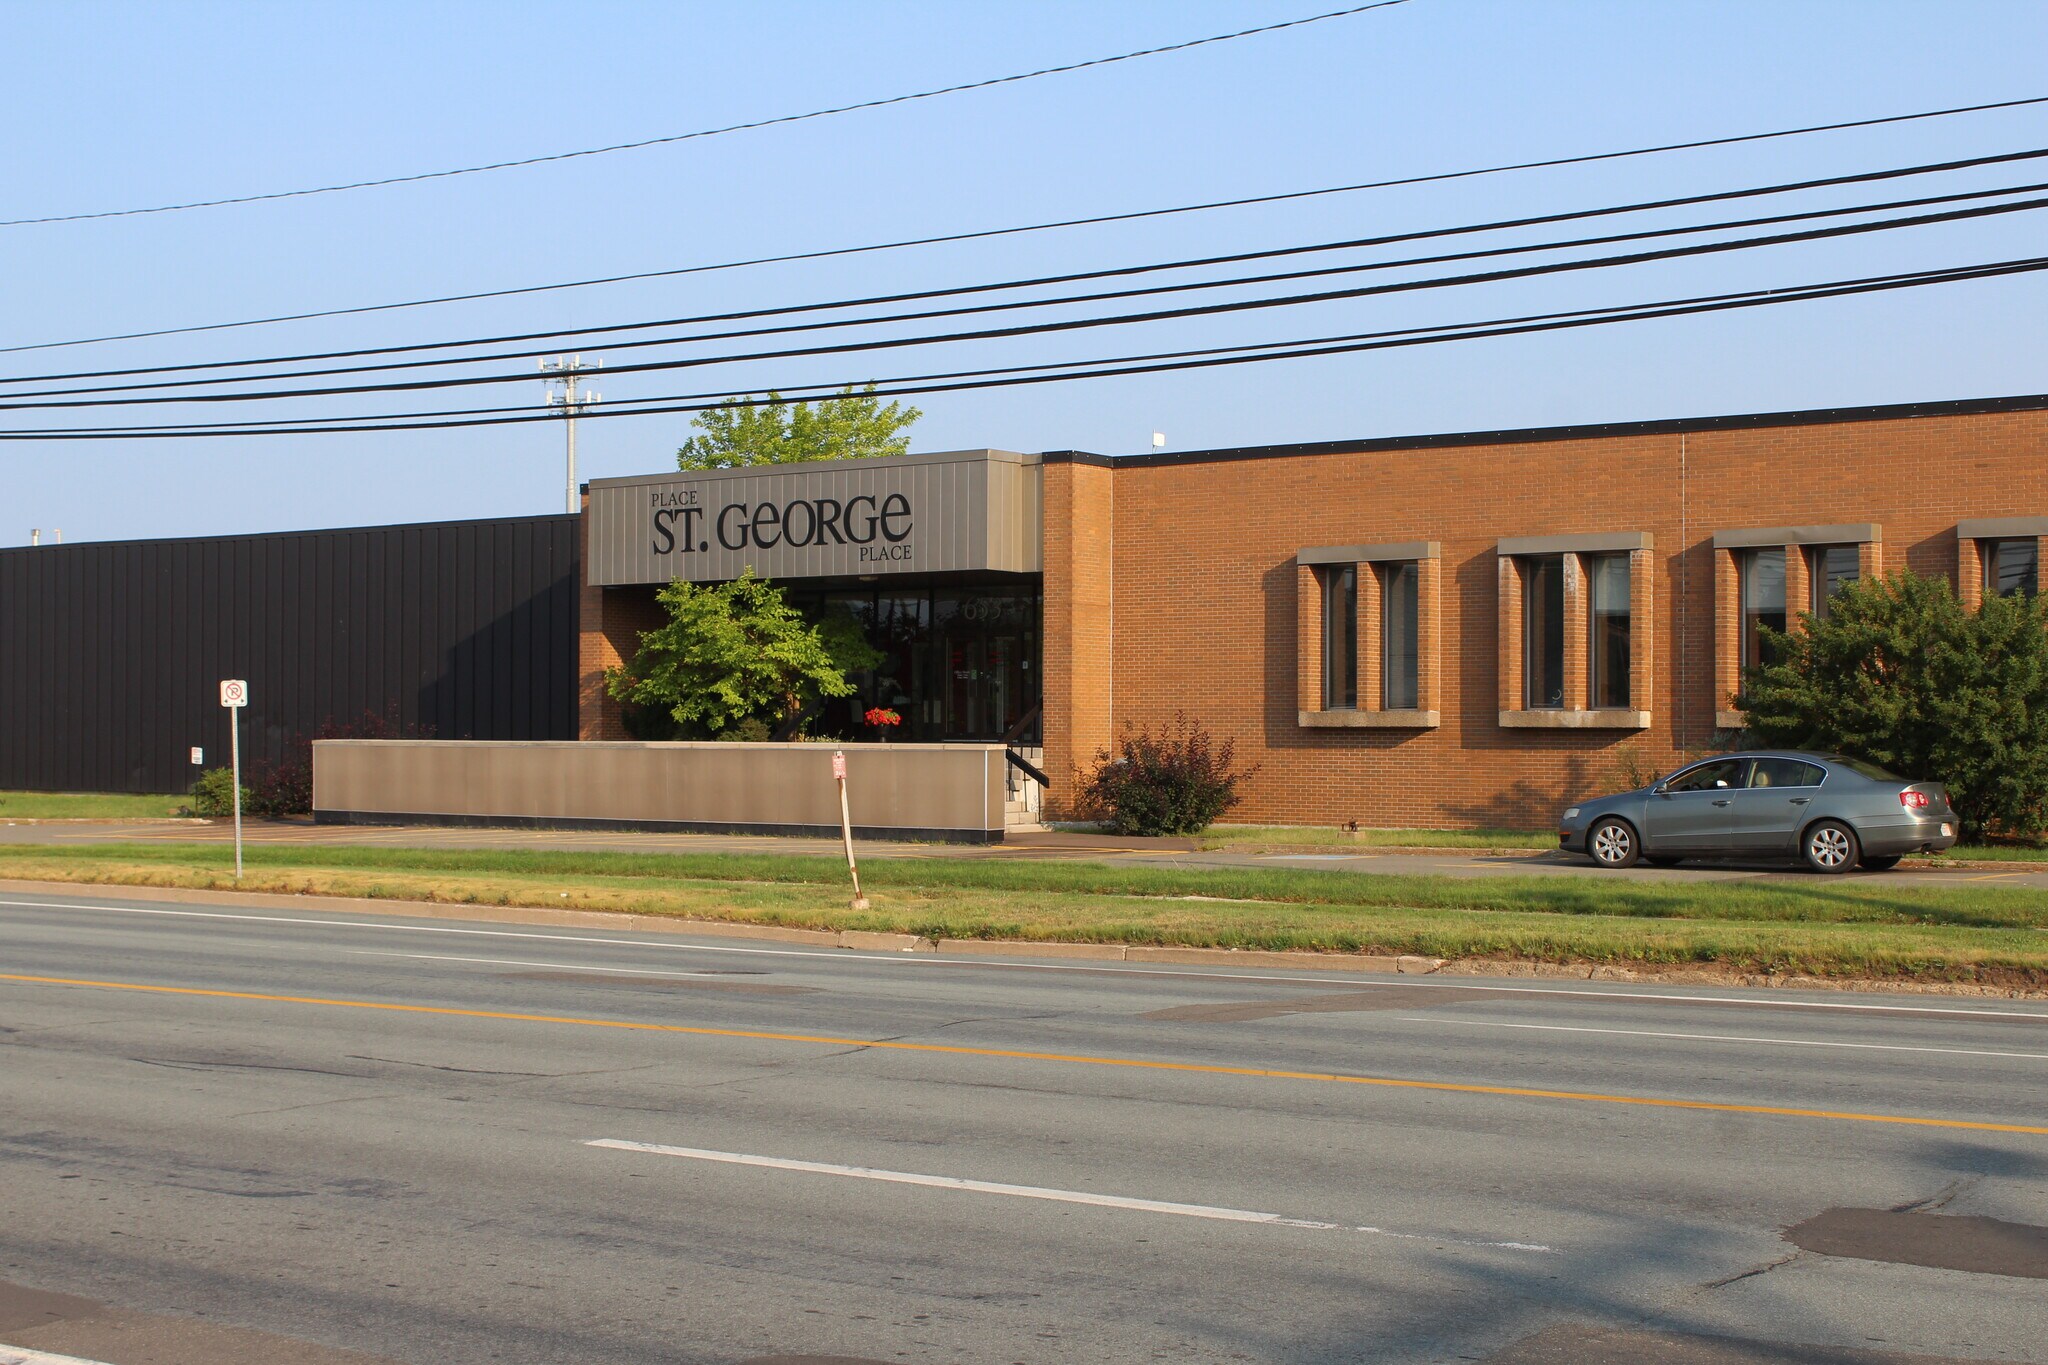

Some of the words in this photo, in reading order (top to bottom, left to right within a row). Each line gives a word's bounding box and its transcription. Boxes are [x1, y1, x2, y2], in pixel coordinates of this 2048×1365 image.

[651, 490, 698, 507] PLACE
[653, 507, 709, 556] ST.
[859, 544, 913, 562] PLACE
